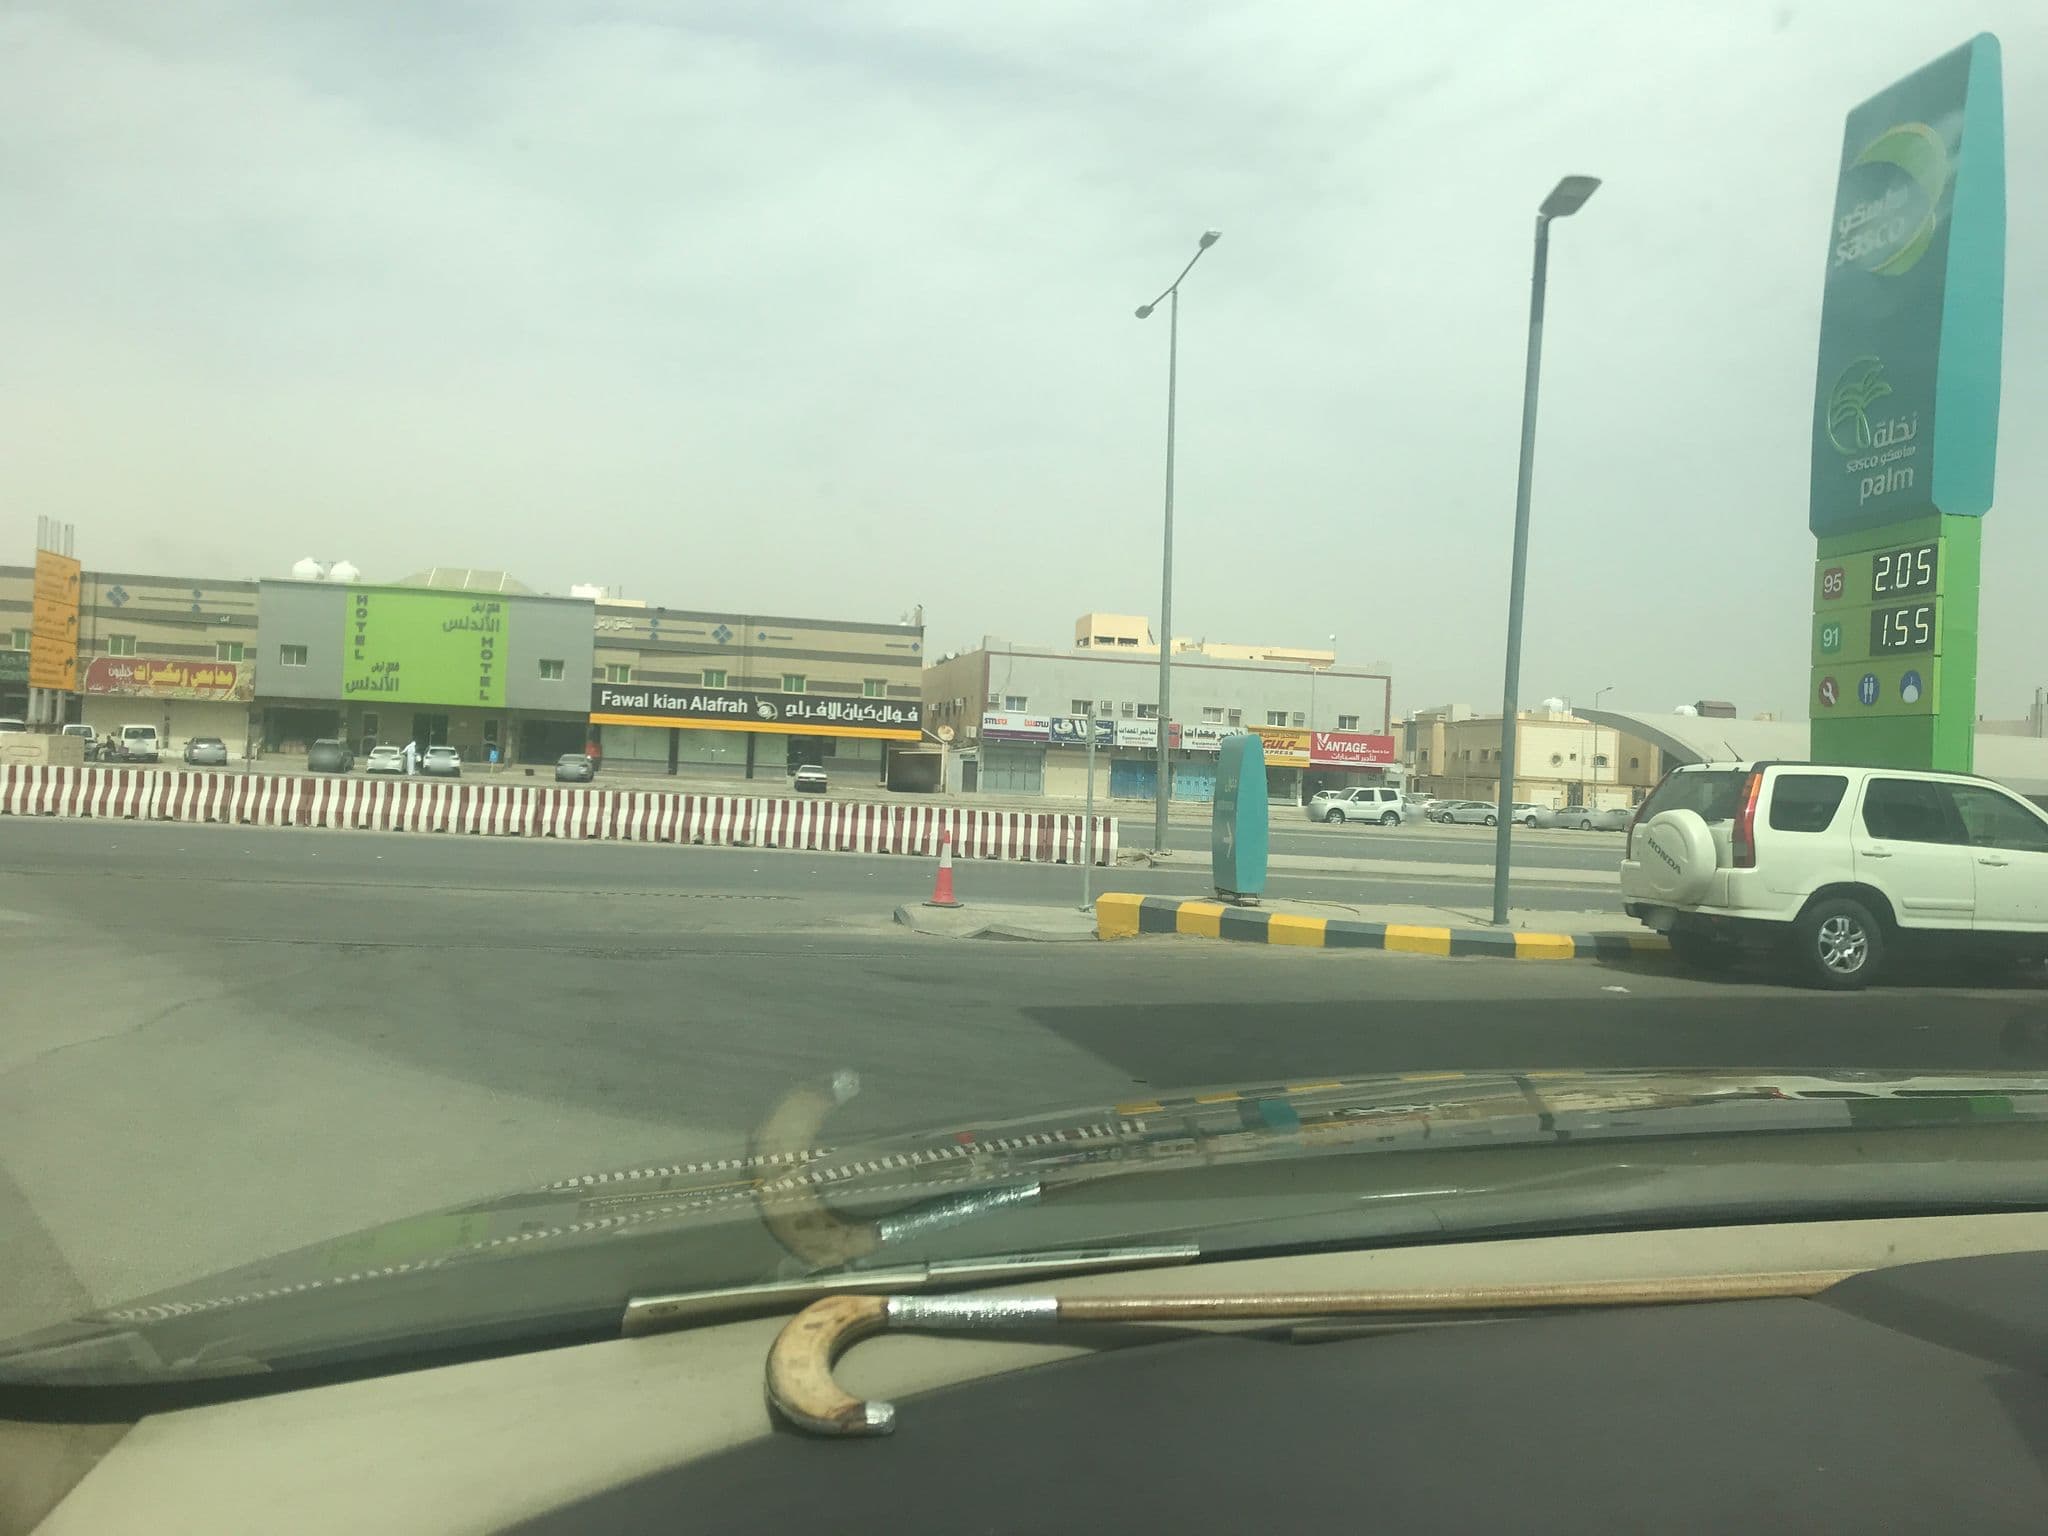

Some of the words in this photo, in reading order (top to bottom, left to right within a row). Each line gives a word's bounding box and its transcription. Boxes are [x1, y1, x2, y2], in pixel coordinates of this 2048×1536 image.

[1873, 410, 1919, 449] نخلة
[1860, 466, 1914, 505] palm
[1874, 548, 1932, 592] 2.05
[1823, 573, 1842, 593] 95
[1823, 627, 1840, 648] 91
[1882, 607, 1930, 646] 1.55
[601, 690, 649, 708] Fawal
[653, 693, 688, 710] kian
[690, 695, 748, 714] Alafrah
[843, 703, 875, 721] كيان
[876, 706, 919, 724] فوال
[1262, 739, 1296, 750] GULF
[1316, 732, 1367, 754] VANTAGE
[1648, 838, 1681, 875] HONDA
